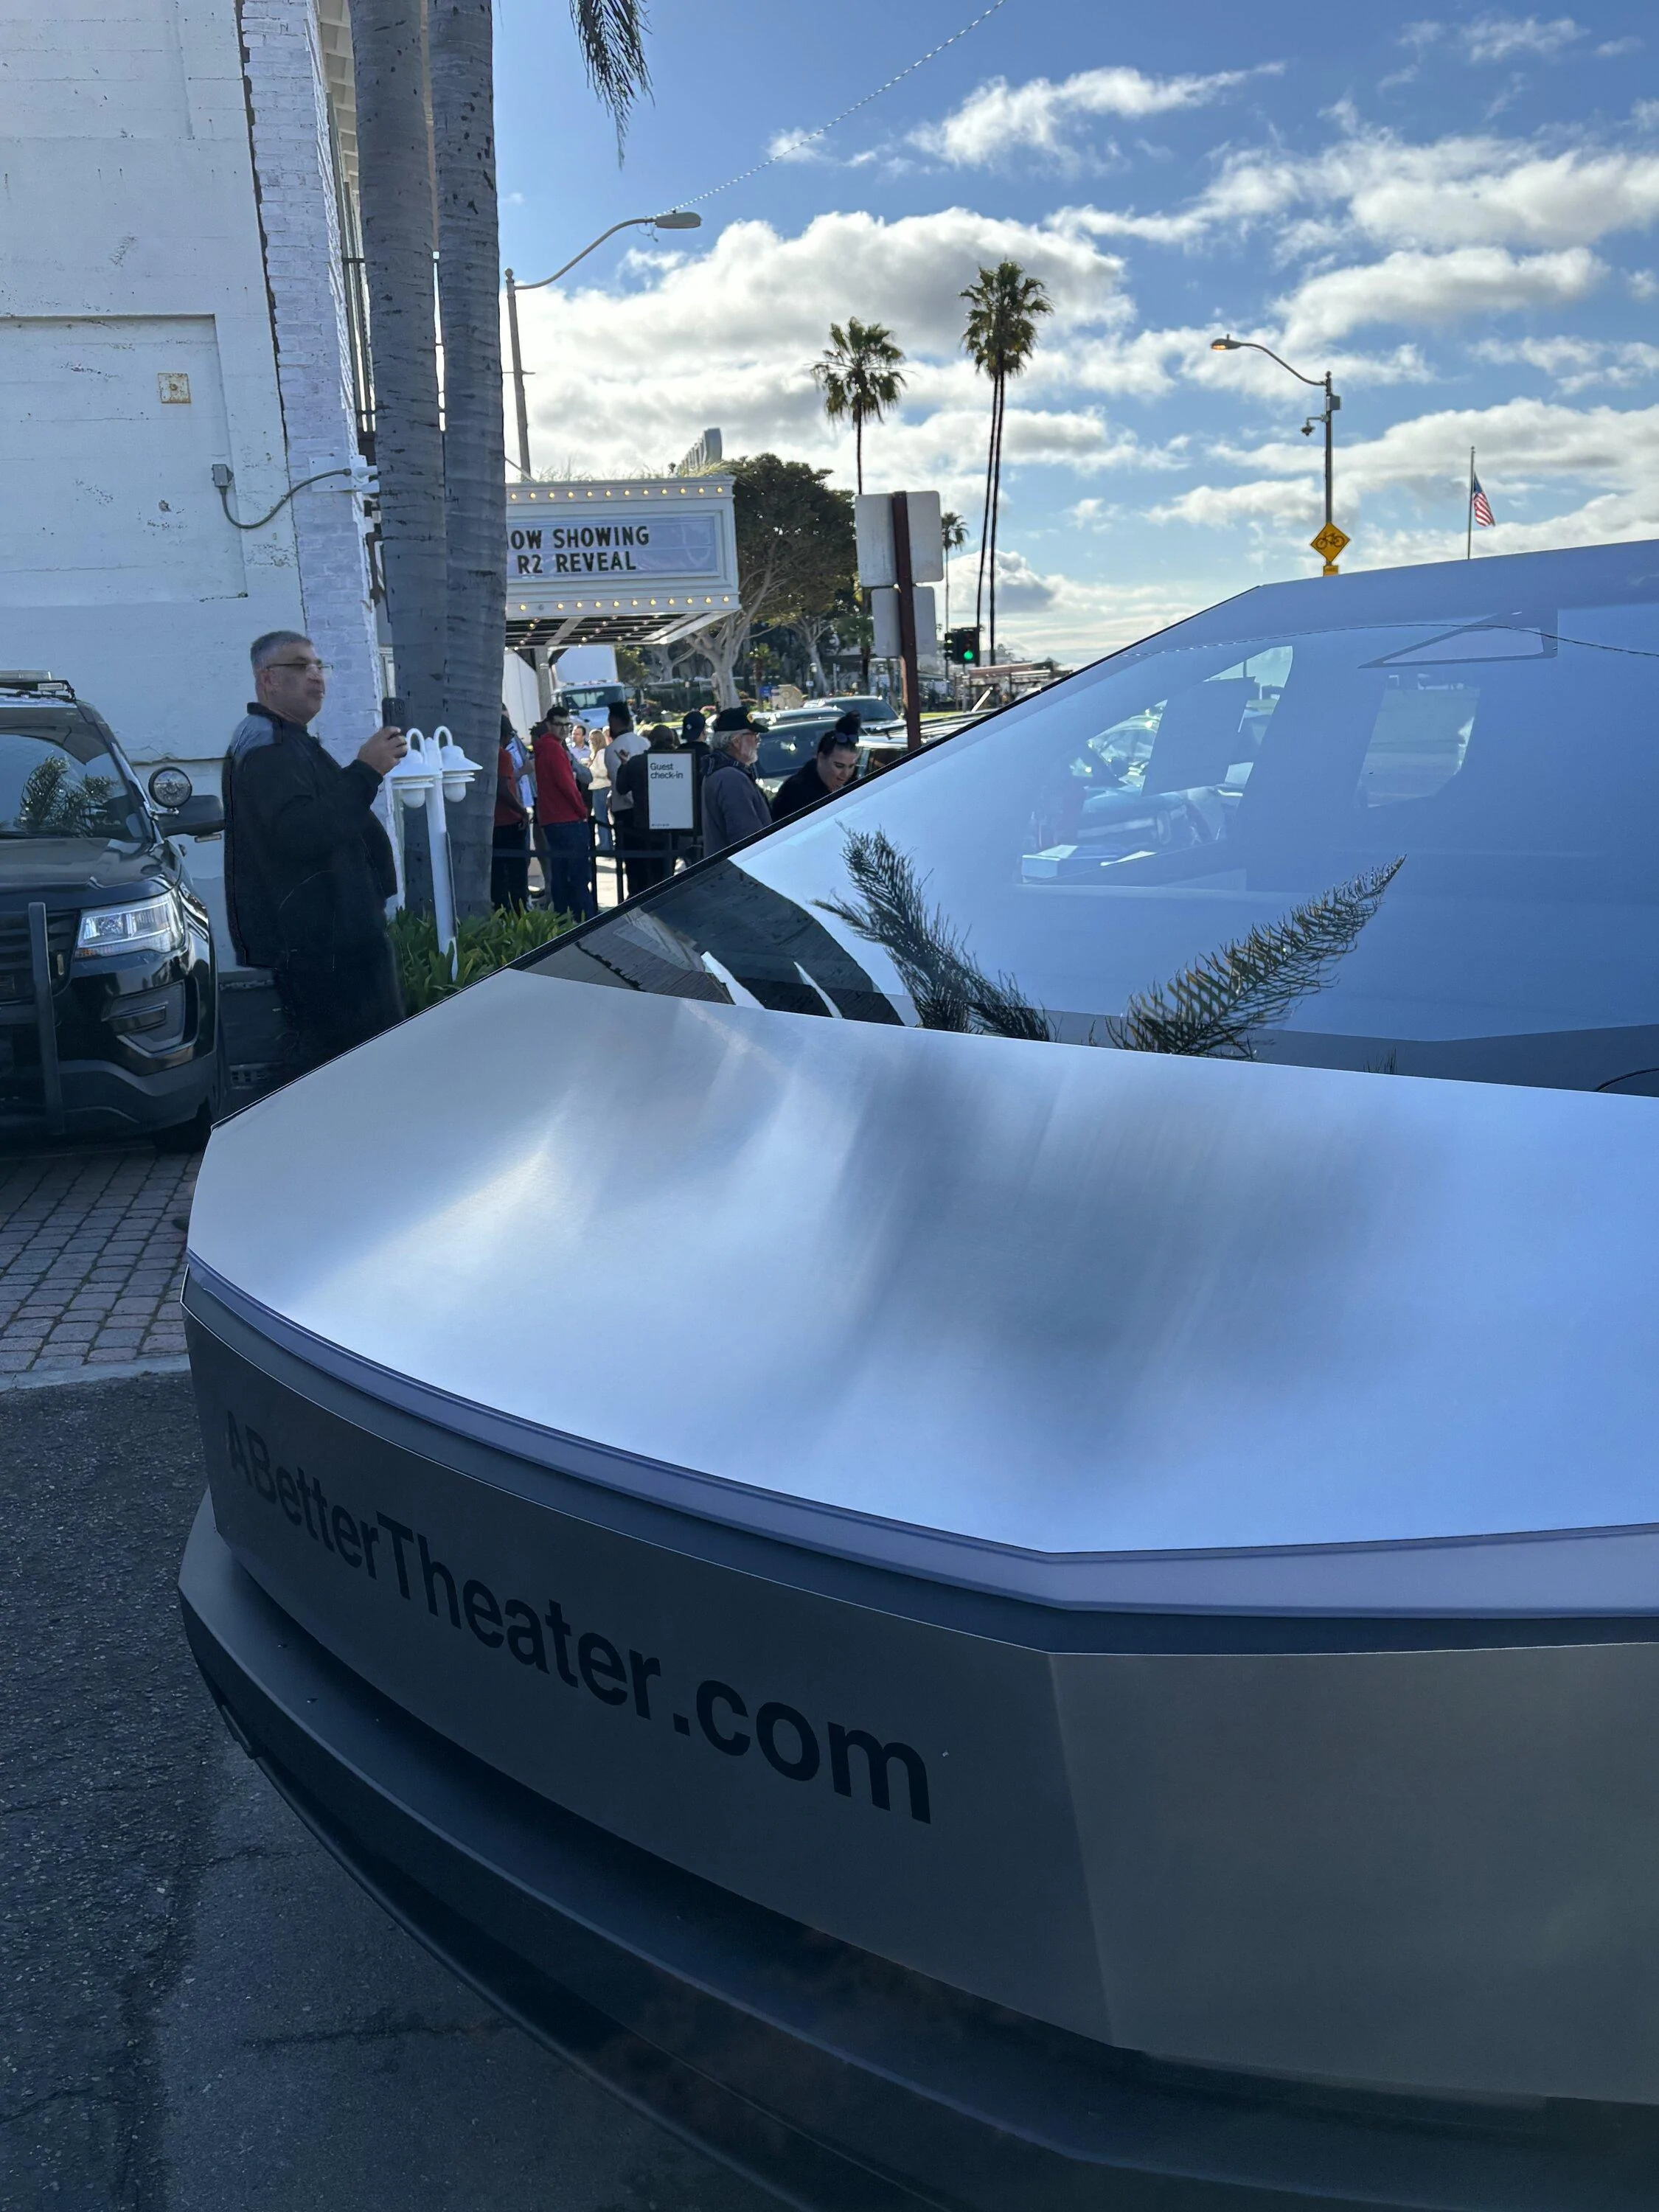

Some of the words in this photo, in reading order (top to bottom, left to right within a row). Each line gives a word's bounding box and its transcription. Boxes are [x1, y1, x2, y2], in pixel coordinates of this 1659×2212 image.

[507, 529, 542, 550] OW
[552, 526, 649, 549] SHOWING
[518, 554, 543, 574] R2
[555, 551, 636, 572] REVEAL
[650, 762, 674, 771] Guest
[650, 771, 684, 779] check-in
[227, 1411, 931, 1825] ABetterTheater.com
